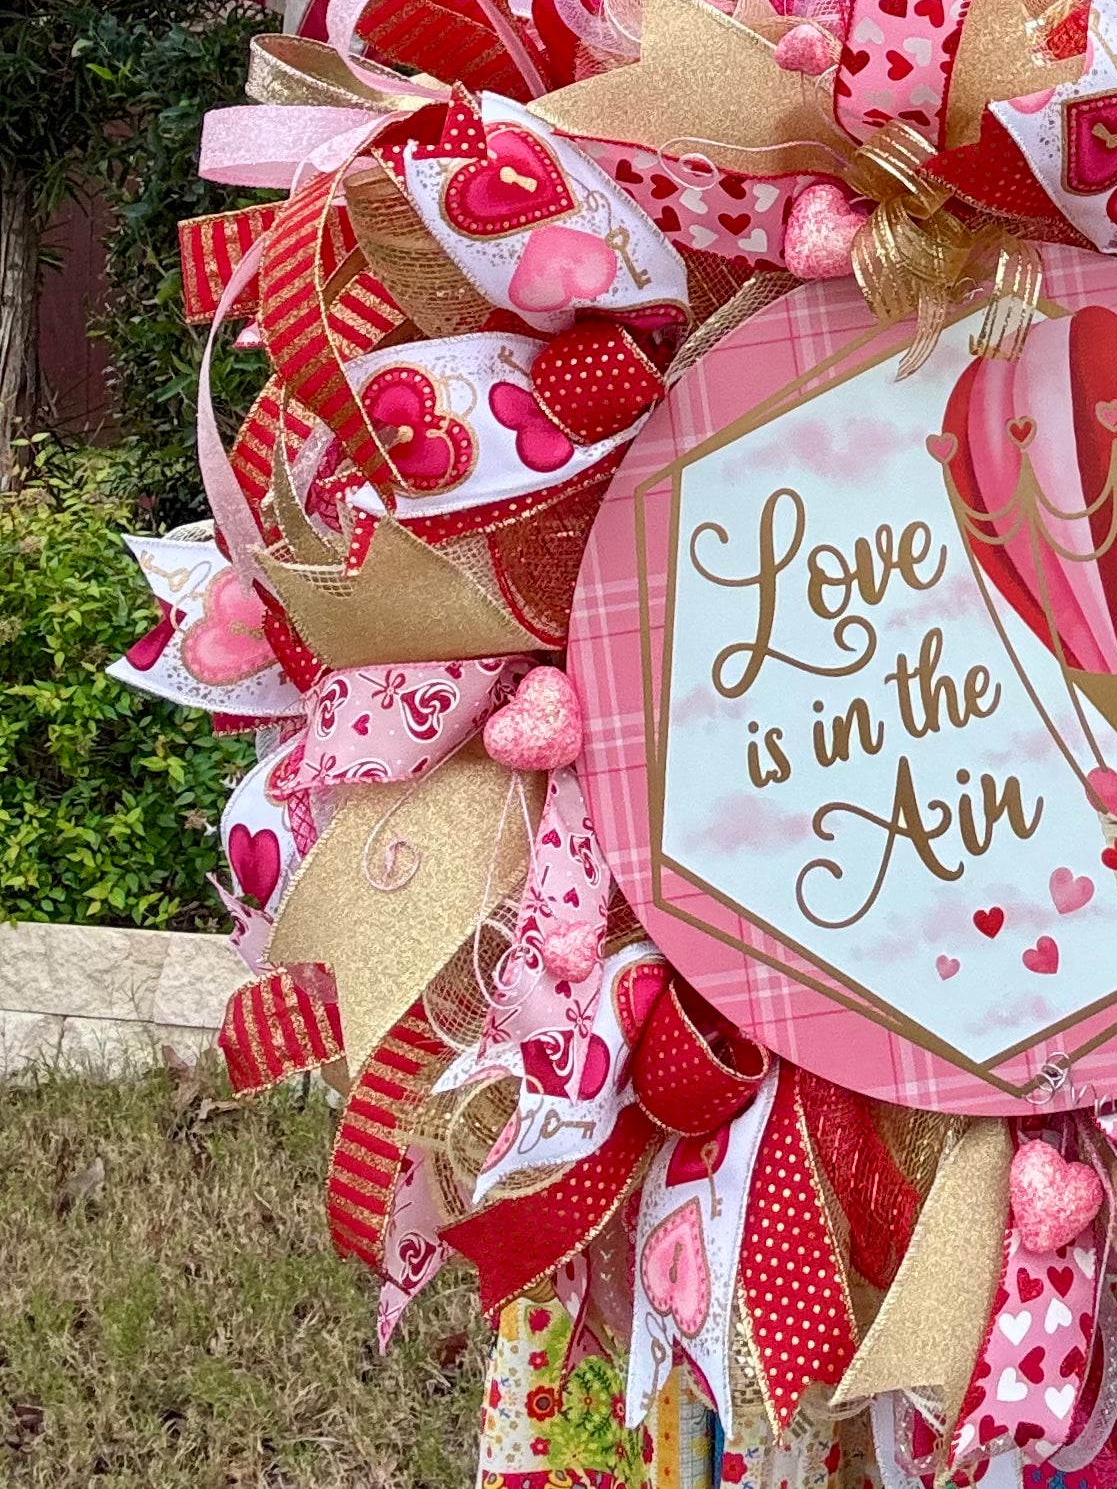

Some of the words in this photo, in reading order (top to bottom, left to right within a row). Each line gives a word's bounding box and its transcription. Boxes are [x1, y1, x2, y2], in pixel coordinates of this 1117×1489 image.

[690, 488, 947, 698] Love
[747, 721, 791, 787] is
[812, 698, 884, 768] in
[884, 627, 1001, 738] the
[796, 755, 1043, 929] Air
